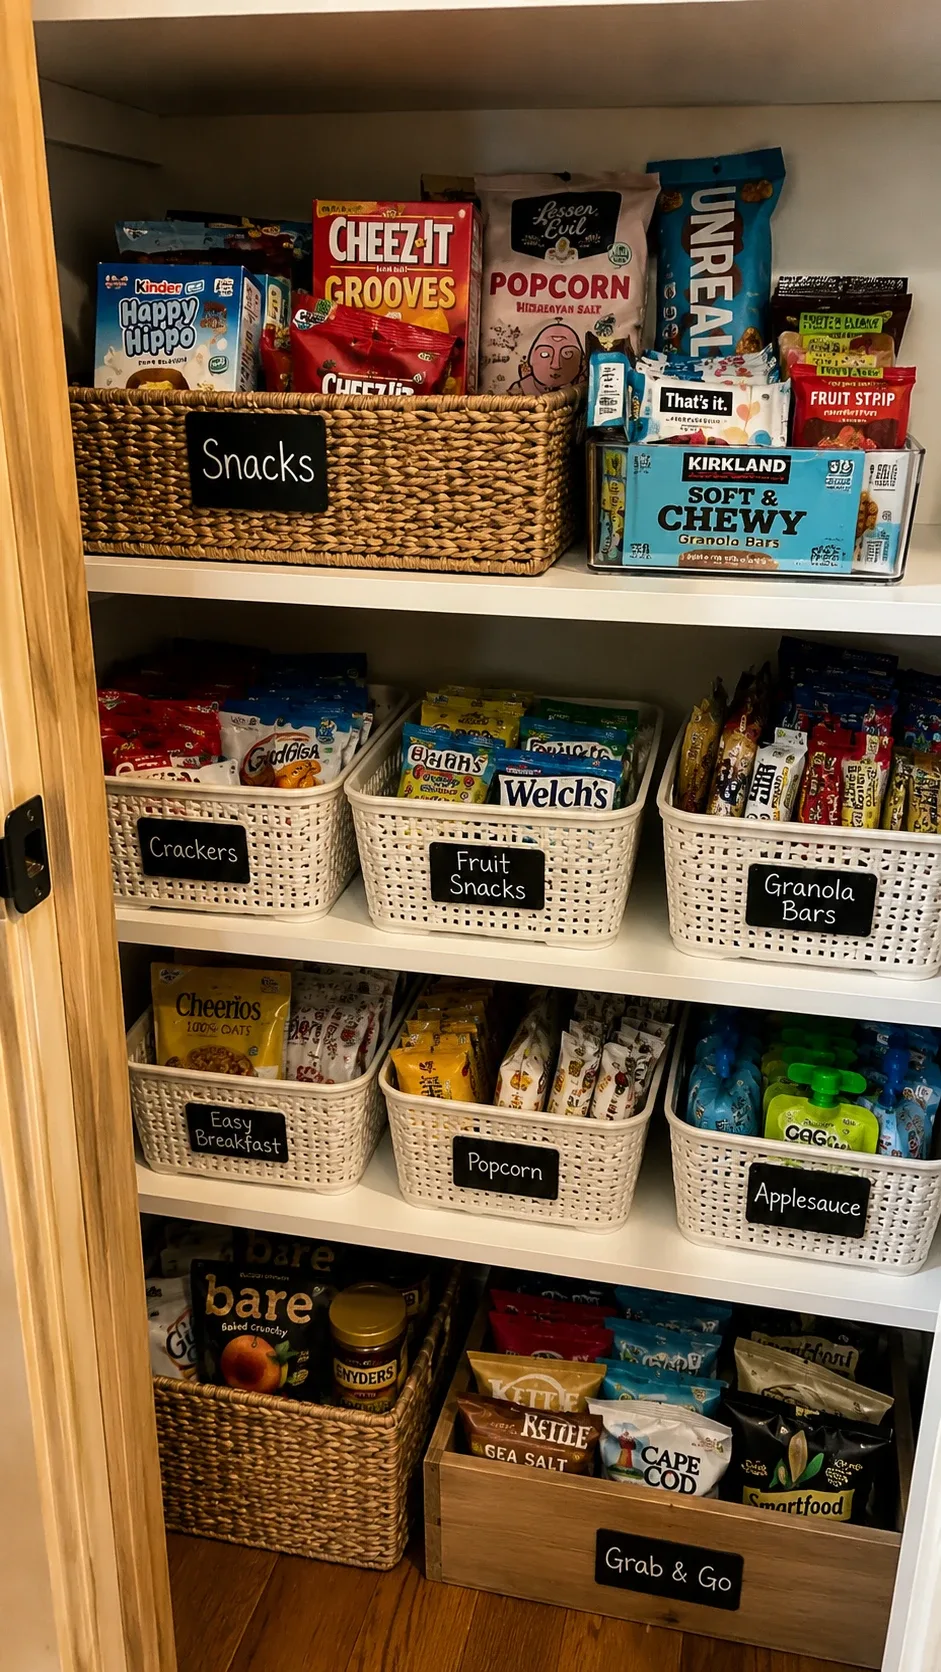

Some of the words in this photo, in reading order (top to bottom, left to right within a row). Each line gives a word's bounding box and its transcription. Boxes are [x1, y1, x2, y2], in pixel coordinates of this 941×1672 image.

[543, 217, 587, 239] Evil
[690, 186, 737, 358] UNREAL
[135, 279, 183, 294] Kinder
[325, 275, 456, 309] GROOVES
[489, 272, 631, 300] POPCORN
[120, 297, 198, 328] Happy
[124, 326, 196, 356] Hippo
[666, 392, 709, 410] That's
[712, 396, 728, 411] it.
[810, 391, 851, 406] FRUIT
[855, 391, 896, 407] STRIP
[202, 438, 314, 482] Snacks
[688, 456, 787, 474] KIRKLAND
[688, 486, 755, 505] SOFT
[760, 489, 779, 506] &
[657, 505, 807, 536] CHEWY
[745, 534, 779, 549] Bars
[504, 779, 608, 809] Welch's
[149, 836, 238, 863] Crackers
[457, 851, 510, 874] Fruit
[450, 874, 526, 900] Snacks
[765, 873, 855, 902] Granola
[782, 900, 836, 924] Bars
[176, 992, 262, 1021] Cheerios
[221, 1024, 252, 1036] OATS
[211, 1111, 252, 1134] Easy
[195, 1128, 282, 1154] Breakfast
[468, 1152, 543, 1181] Popcorn
[754, 1182, 861, 1216] Applesauce
[205, 1273, 313, 1325] bare
[525, 1452, 568, 1472] SALT
[641, 1446, 701, 1476] CAPE
[643, 1466, 697, 1495] COD
[749, 1493, 844, 1516] Smartfood
[605, 1546, 663, 1577] Grab
[672, 1561, 687, 1583] &
[698, 1565, 733, 1591] Go
